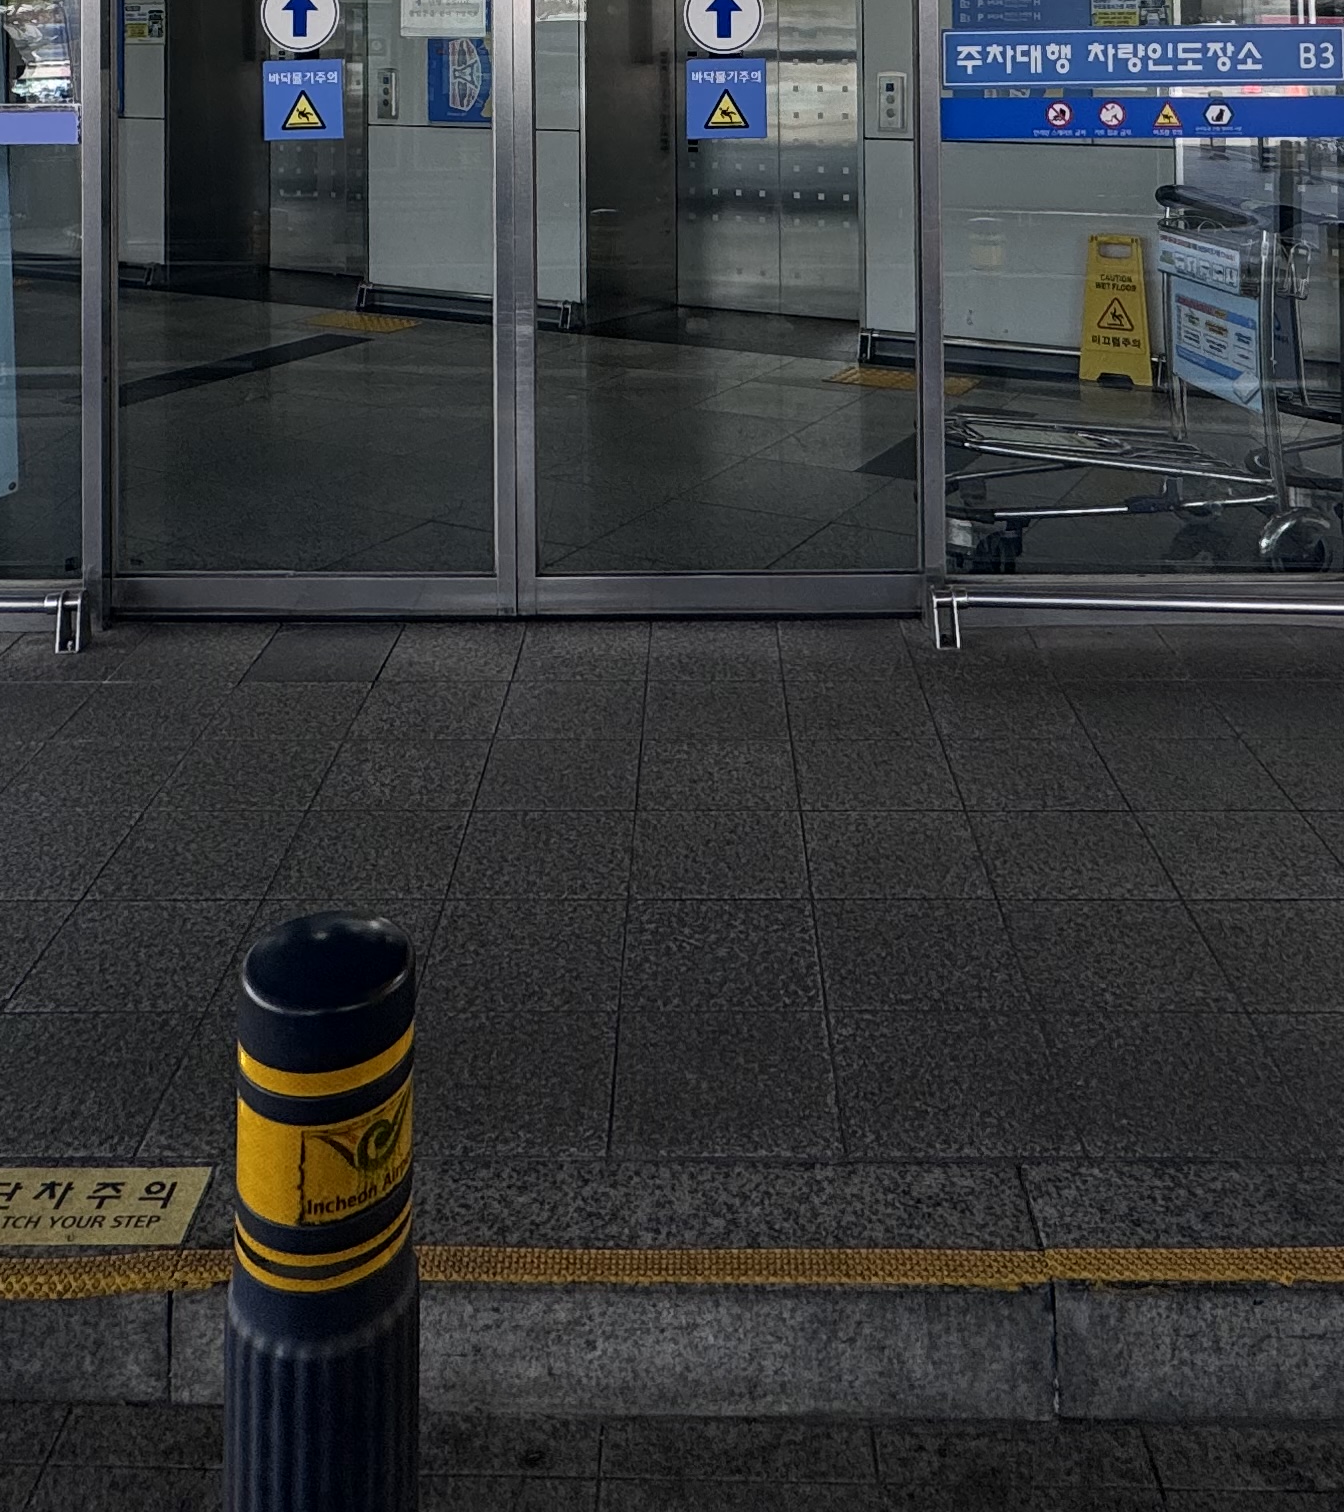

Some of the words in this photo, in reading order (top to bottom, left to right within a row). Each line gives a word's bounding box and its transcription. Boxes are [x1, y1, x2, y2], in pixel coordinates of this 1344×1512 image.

[955, 44, 1072, 75] 주차대행
[1087, 41, 1264, 74] 차량인도장소
[1298, 42, 1336, 71] B3
[268, 70, 339, 86] 바닥물기주의
[691, 70, 762, 84] 바닥물기주의
[1095, 281, 1111, 290] WET
[1100, 273, 1133, 283] CAUTION
[306, 1183, 378, 1217] Incheon
[48, 1214, 106, 1231] YOUR
[111, 1214, 161, 1230] STEP
